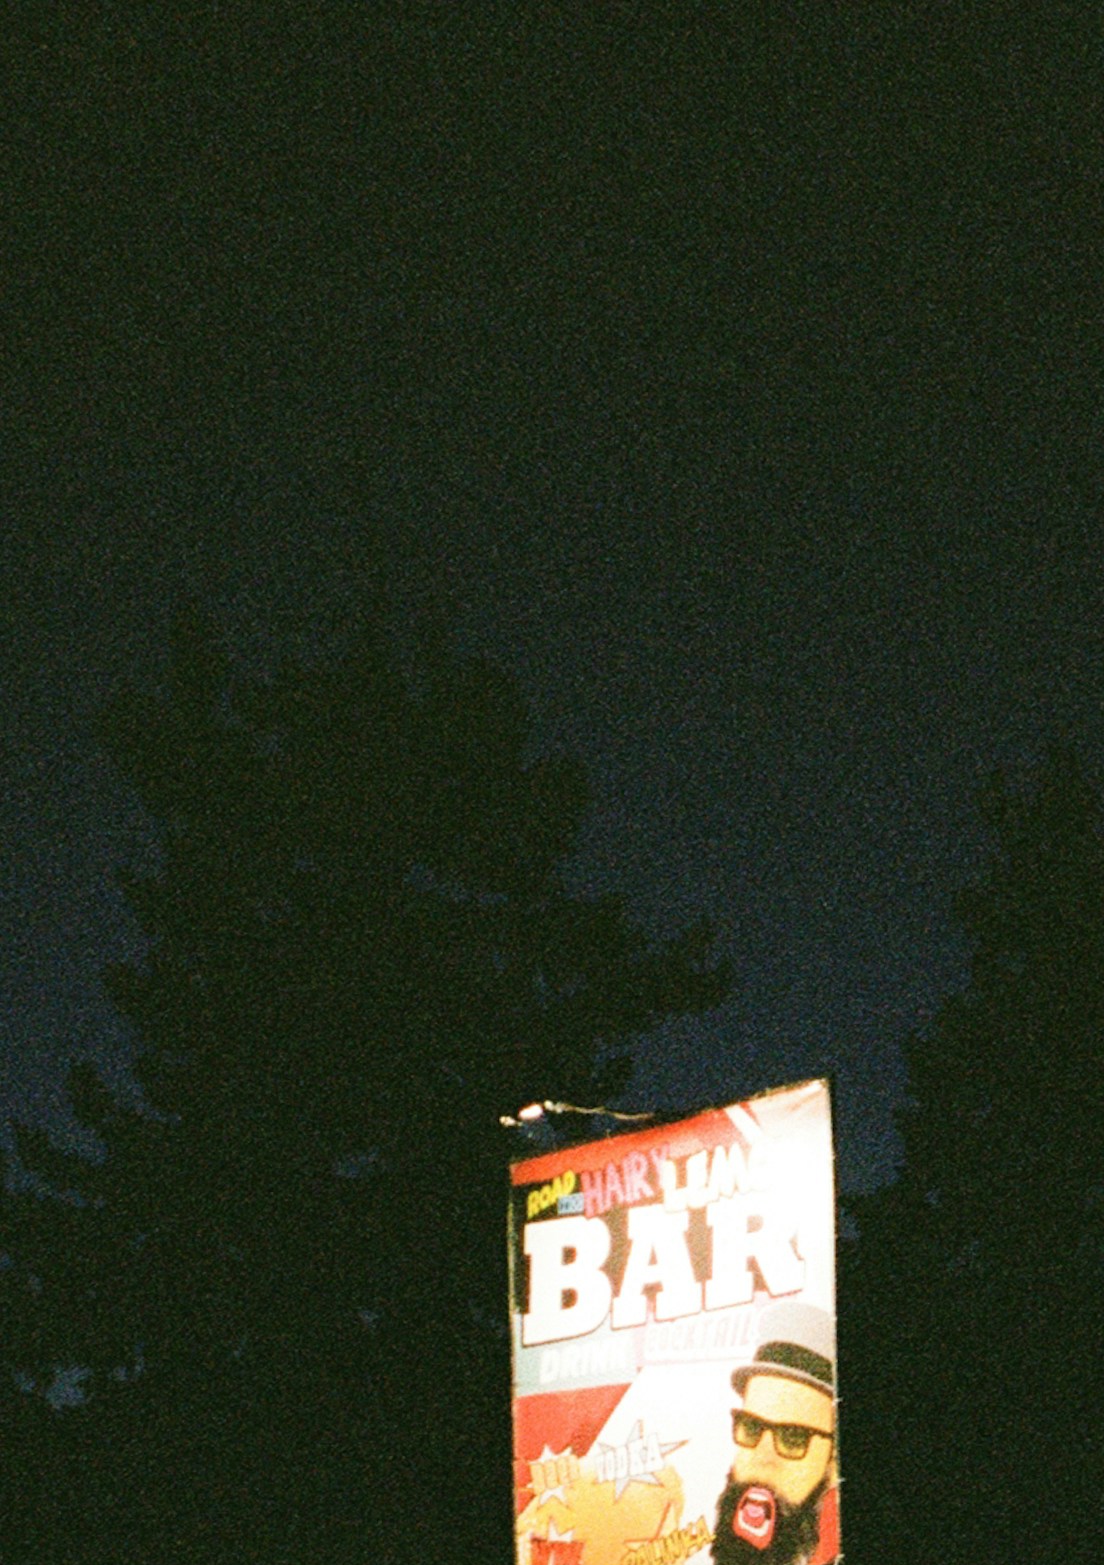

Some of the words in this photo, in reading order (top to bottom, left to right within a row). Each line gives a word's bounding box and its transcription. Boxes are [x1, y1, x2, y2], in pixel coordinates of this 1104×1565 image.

[527, 1169, 576, 1220] ROAD
[580, 1142, 669, 1219] HAIRY
[521, 1200, 807, 1347] BAR
